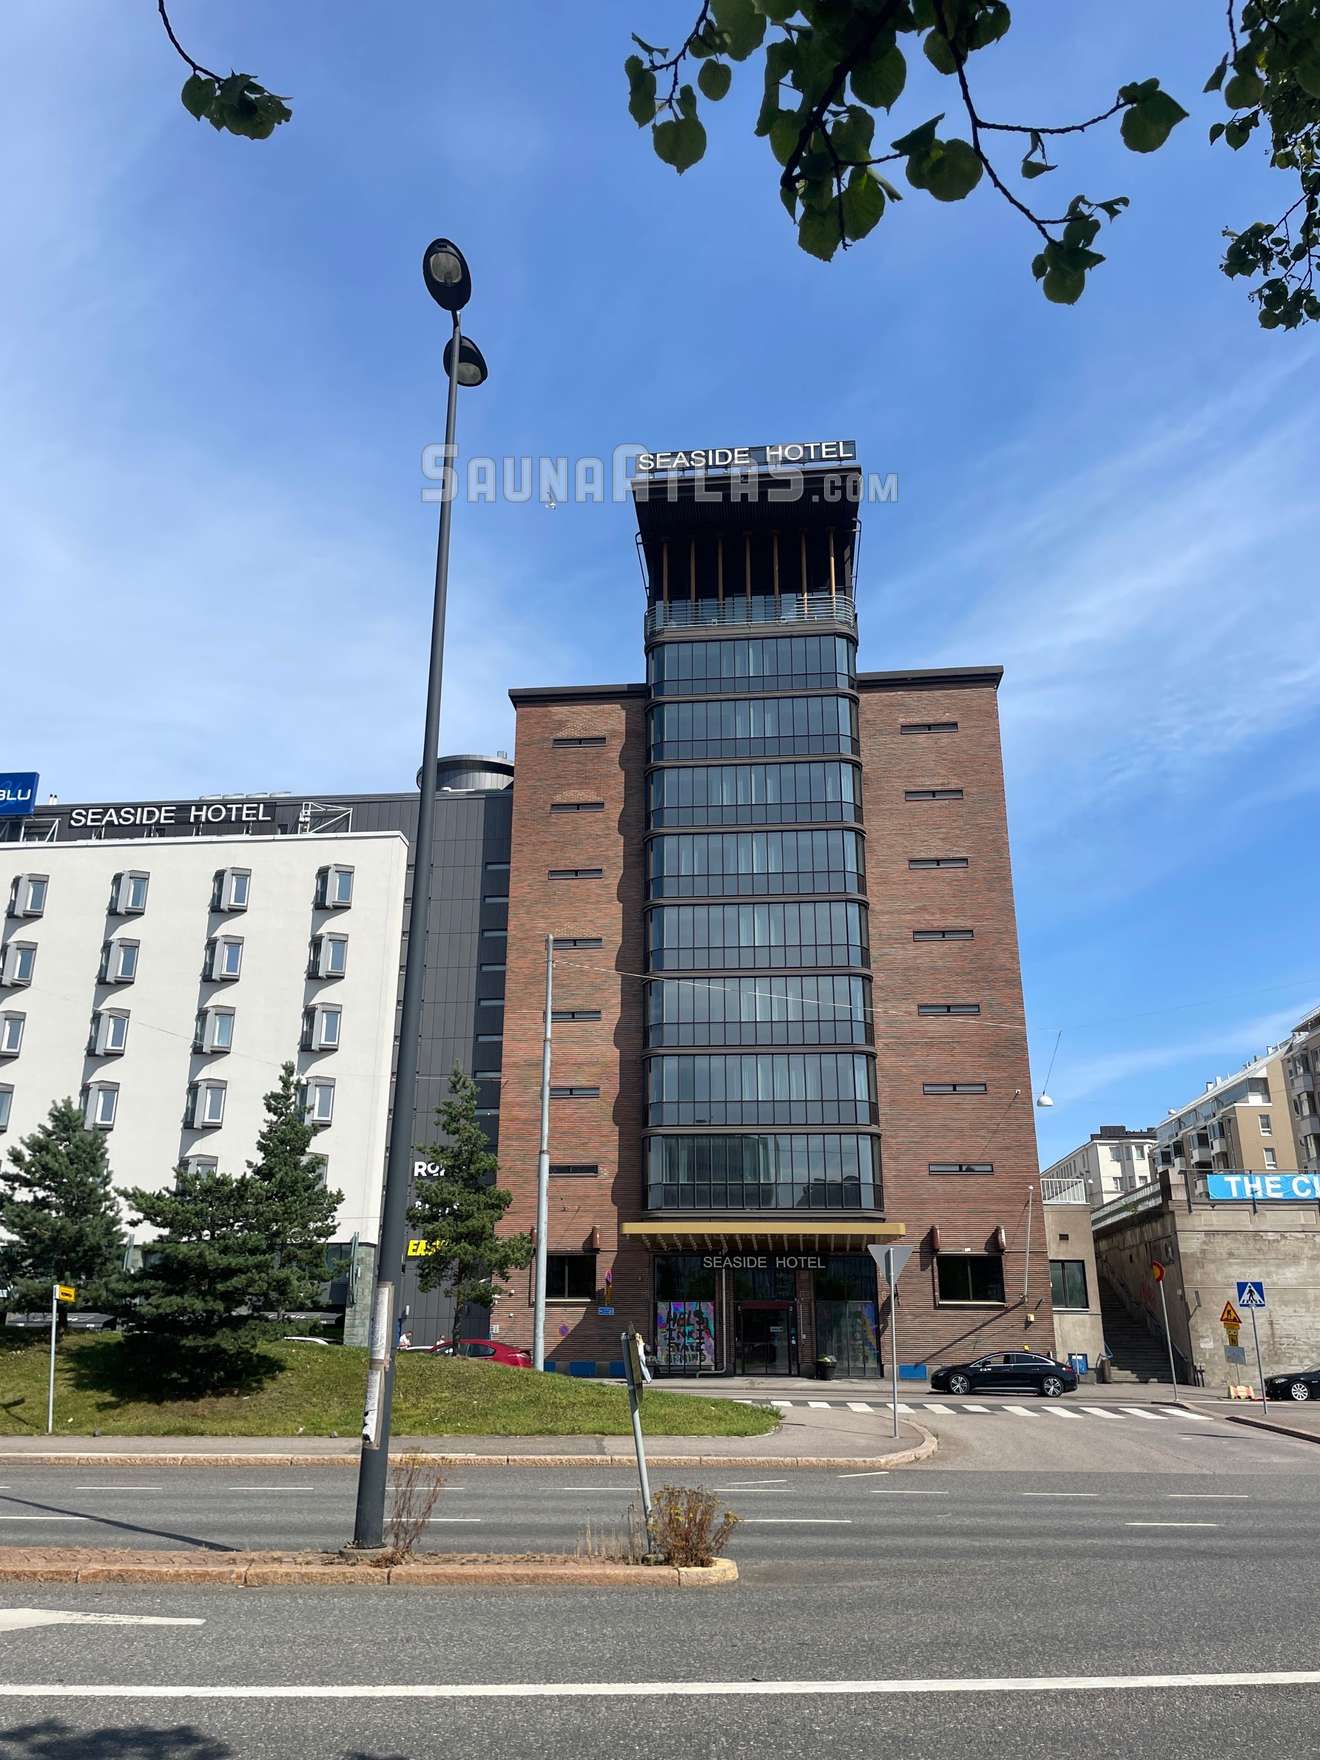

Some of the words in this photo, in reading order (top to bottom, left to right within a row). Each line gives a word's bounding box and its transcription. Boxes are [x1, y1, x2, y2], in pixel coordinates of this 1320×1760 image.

[638, 447, 750, 470] SEASIDE
[766, 441, 853, 462] HOTEL
[70, 806, 177, 828] SEASIDE
[189, 803, 272, 824] HOTEL
[1223, 1176, 1285, 1198] THE
[703, 1256, 768, 1269] SEASIDE
[775, 1256, 827, 1269] HOTEL
